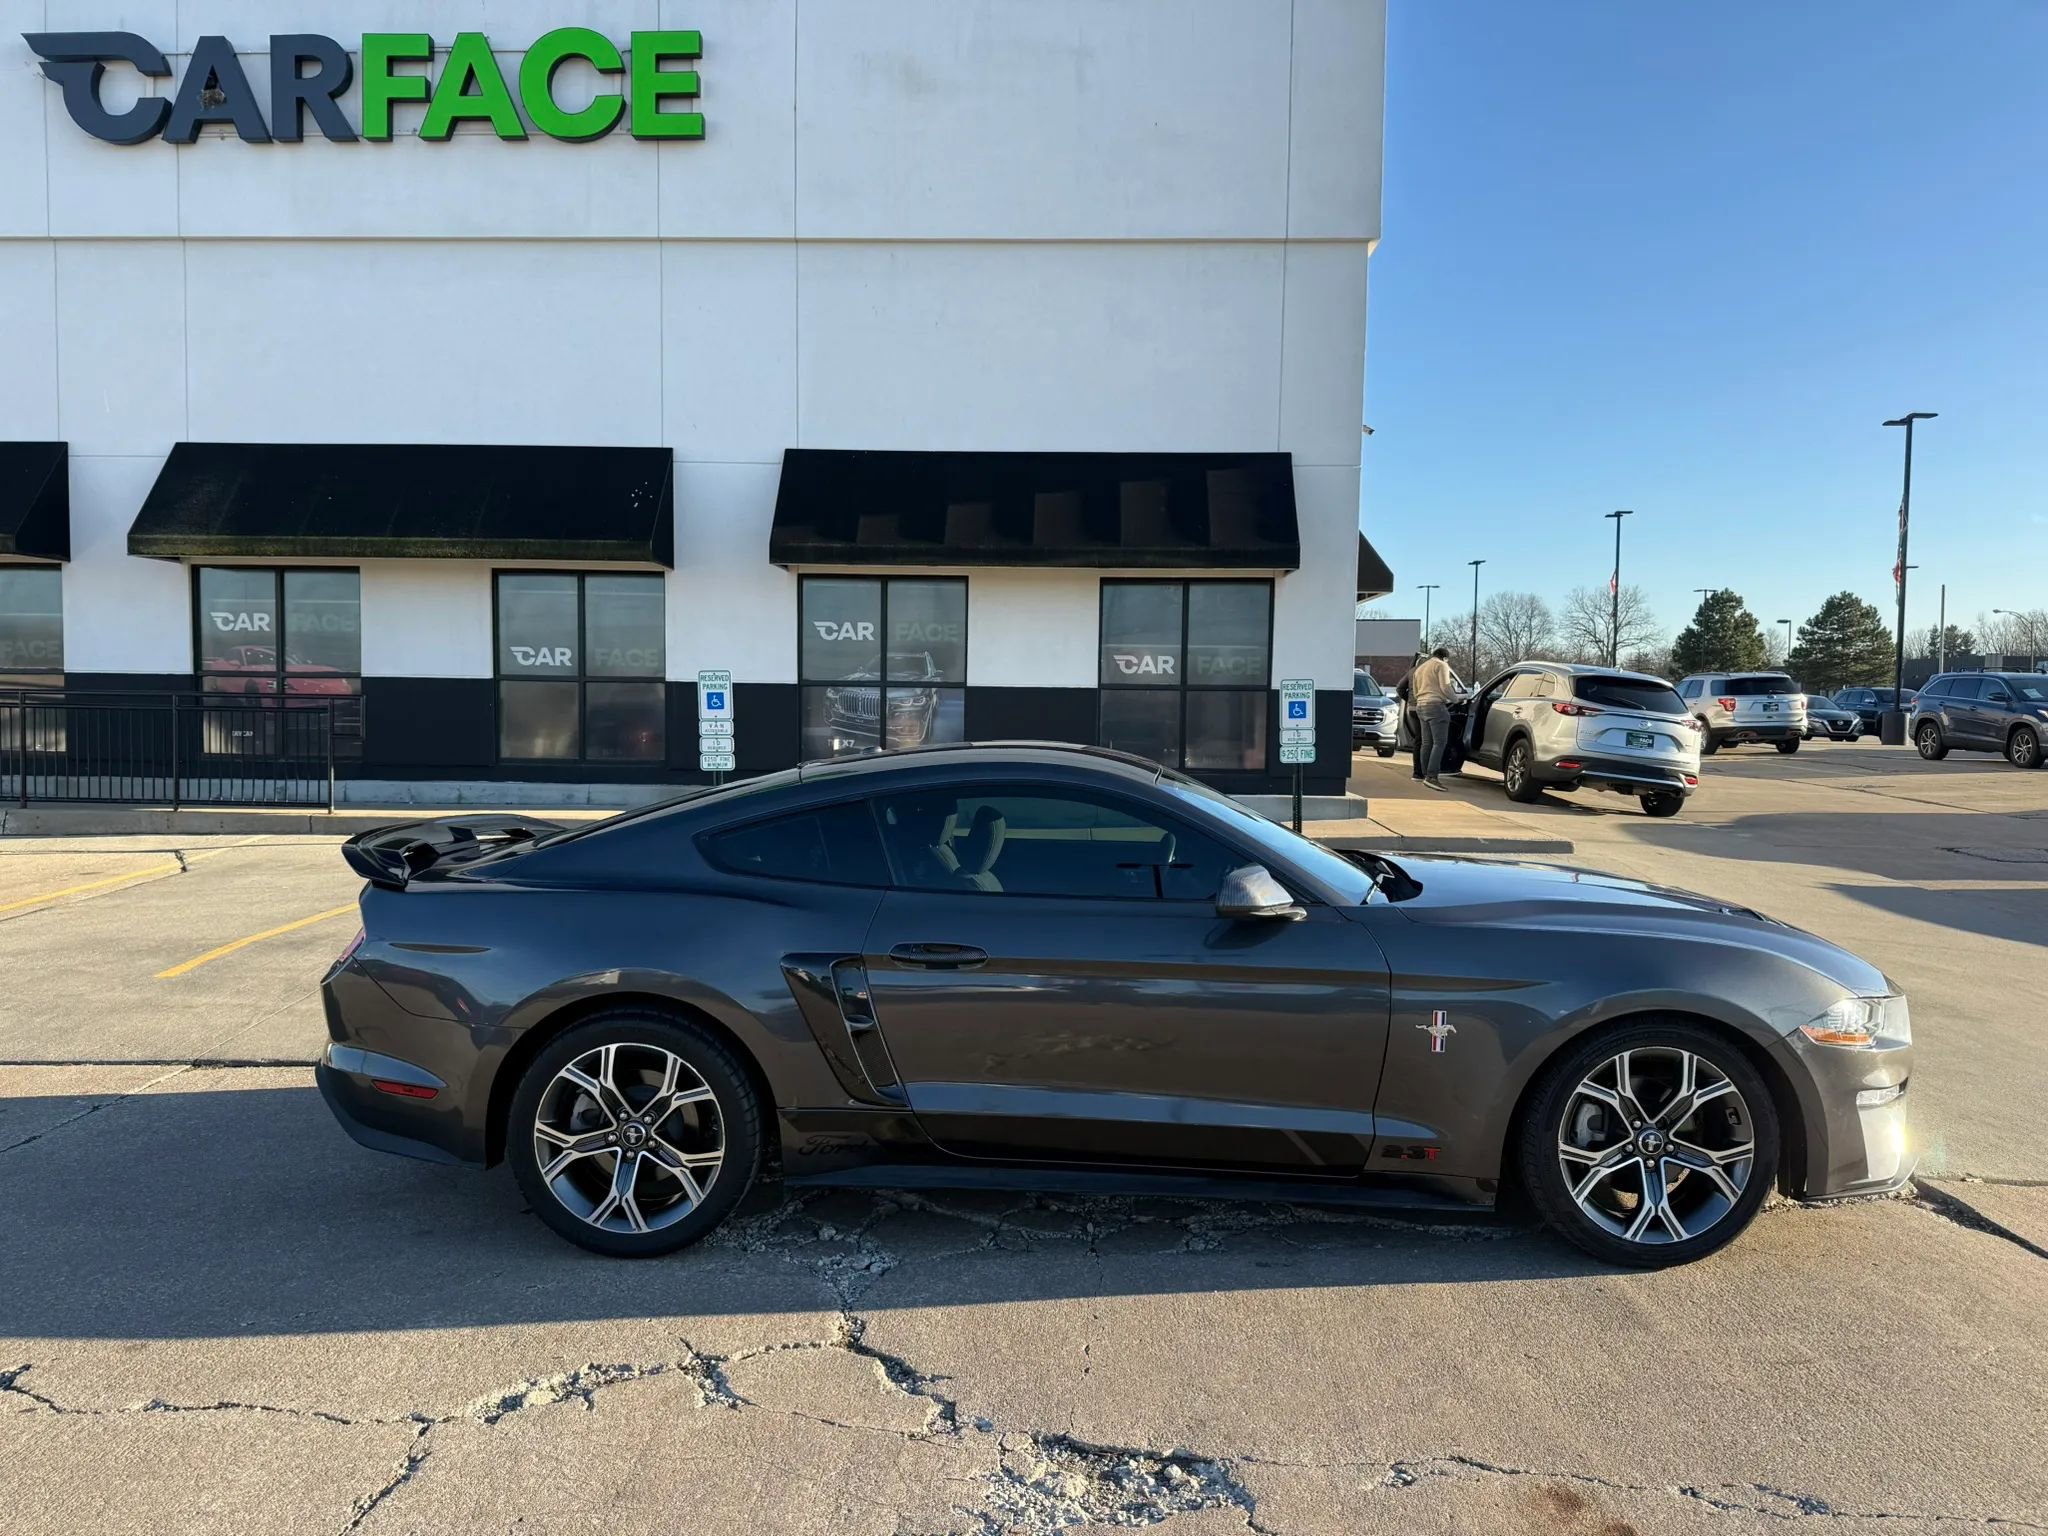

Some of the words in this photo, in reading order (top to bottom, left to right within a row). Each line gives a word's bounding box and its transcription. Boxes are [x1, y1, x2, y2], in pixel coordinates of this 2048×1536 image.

[210, 612, 271, 632] CAR
[812, 621, 874, 641] CAR
[509, 646, 572, 667] CAR
[594, 648, 659, 667] FACE
[1112, 654, 1175, 675] CAR
[1197, 655, 1263, 675] FACE
[700, 674, 730, 682] RESERVED
[1282, 683, 1312, 691] RESERVED
[1281, 750, 1299, 760] $250
[1300, 749, 1313, 759] FINE
